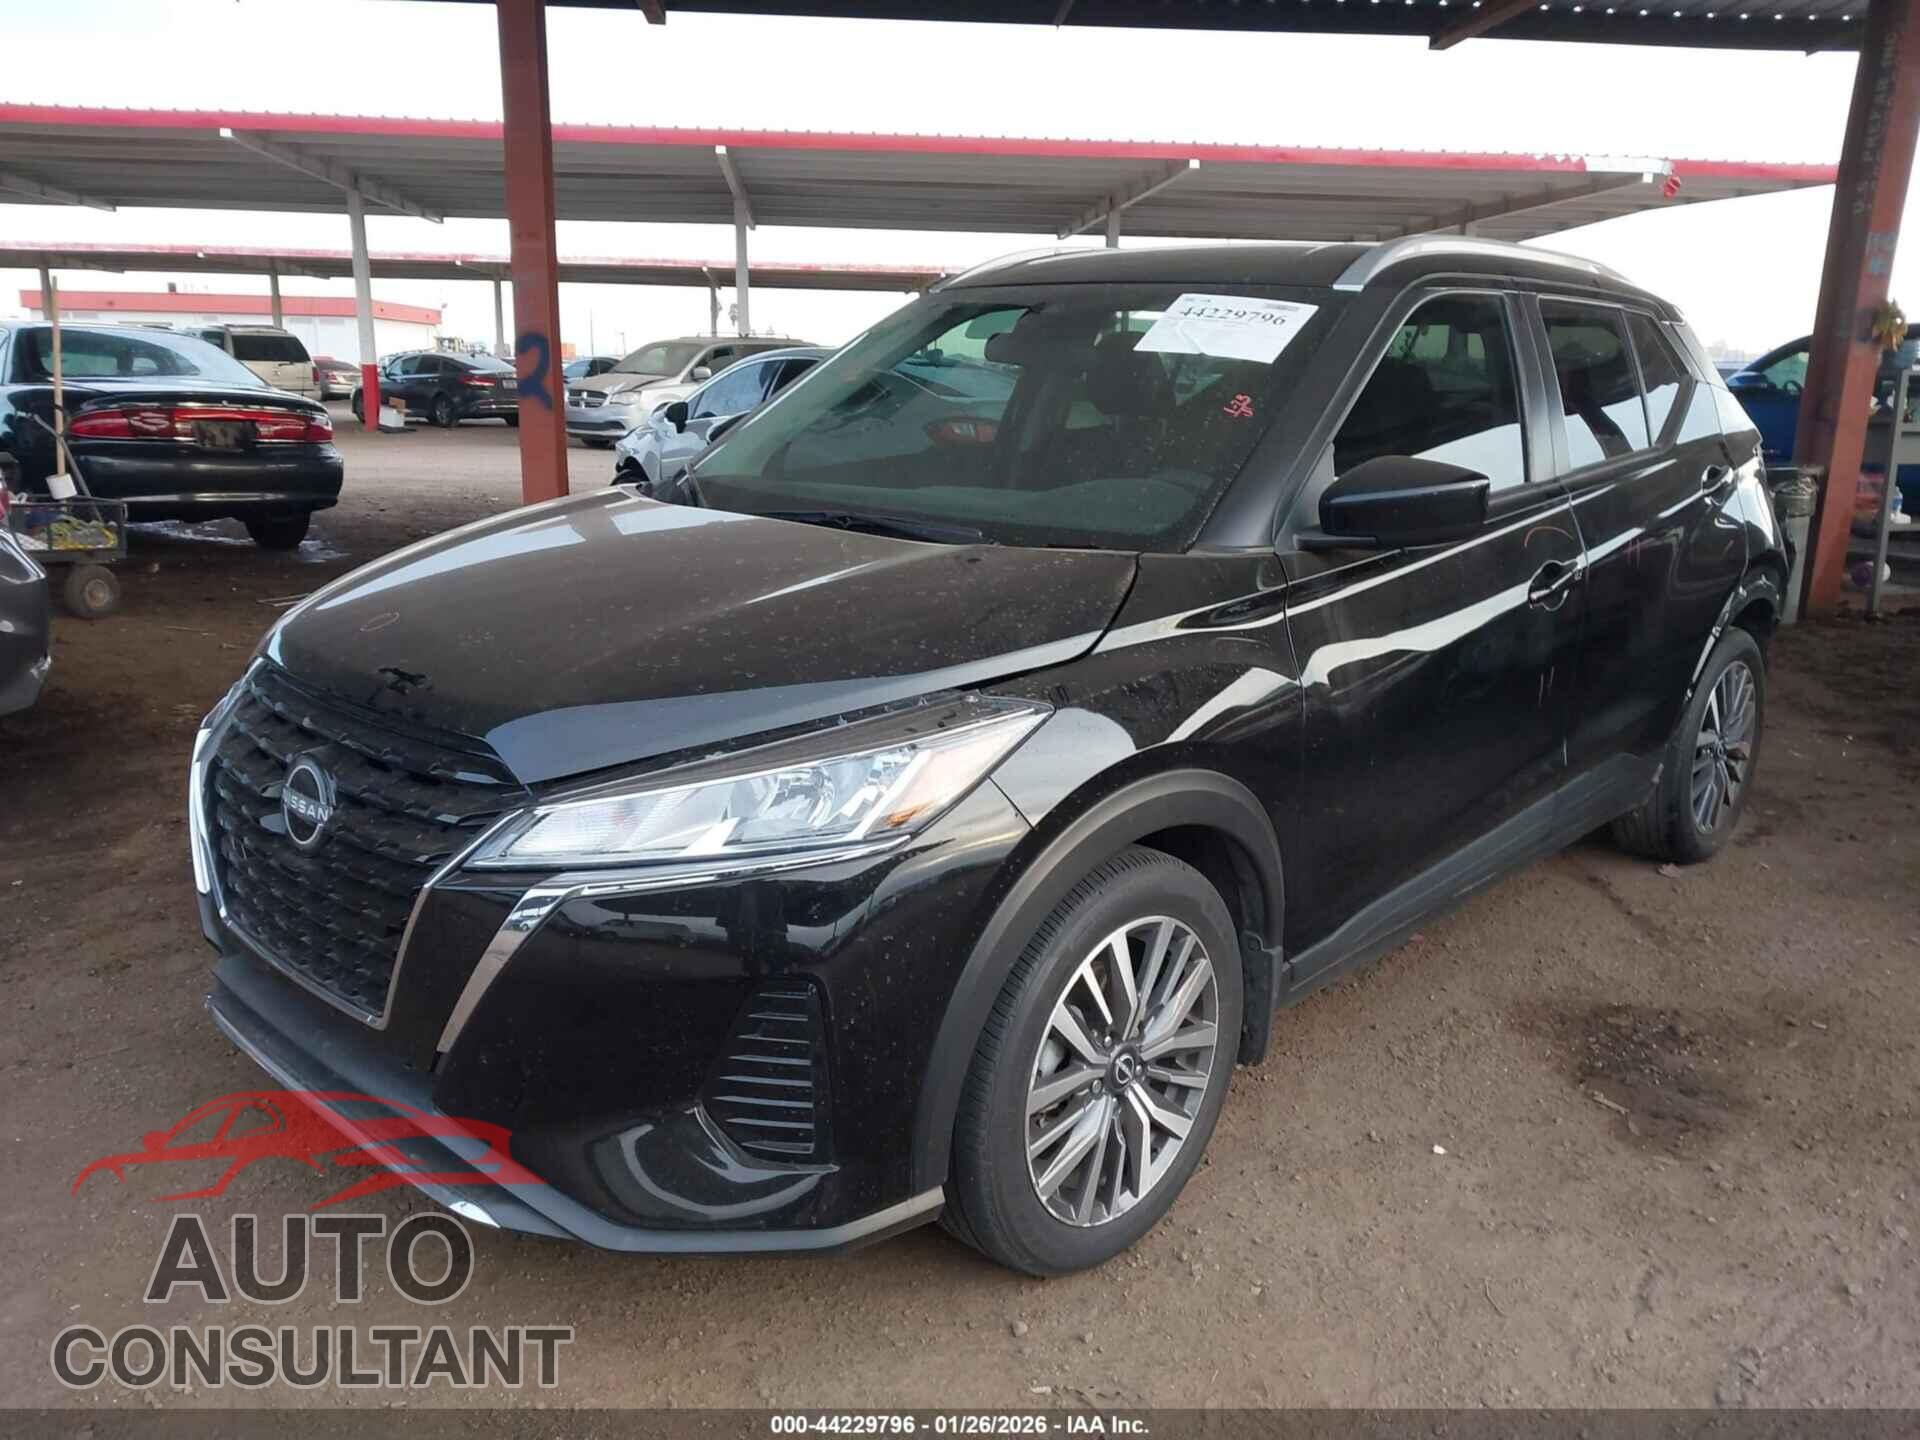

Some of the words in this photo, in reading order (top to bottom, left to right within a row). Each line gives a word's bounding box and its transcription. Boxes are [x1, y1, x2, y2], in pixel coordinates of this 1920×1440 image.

[1180, 306, 1287, 327] 44229796
[516, 332, 552, 411] 2
[283, 788, 329, 823] SSAN
